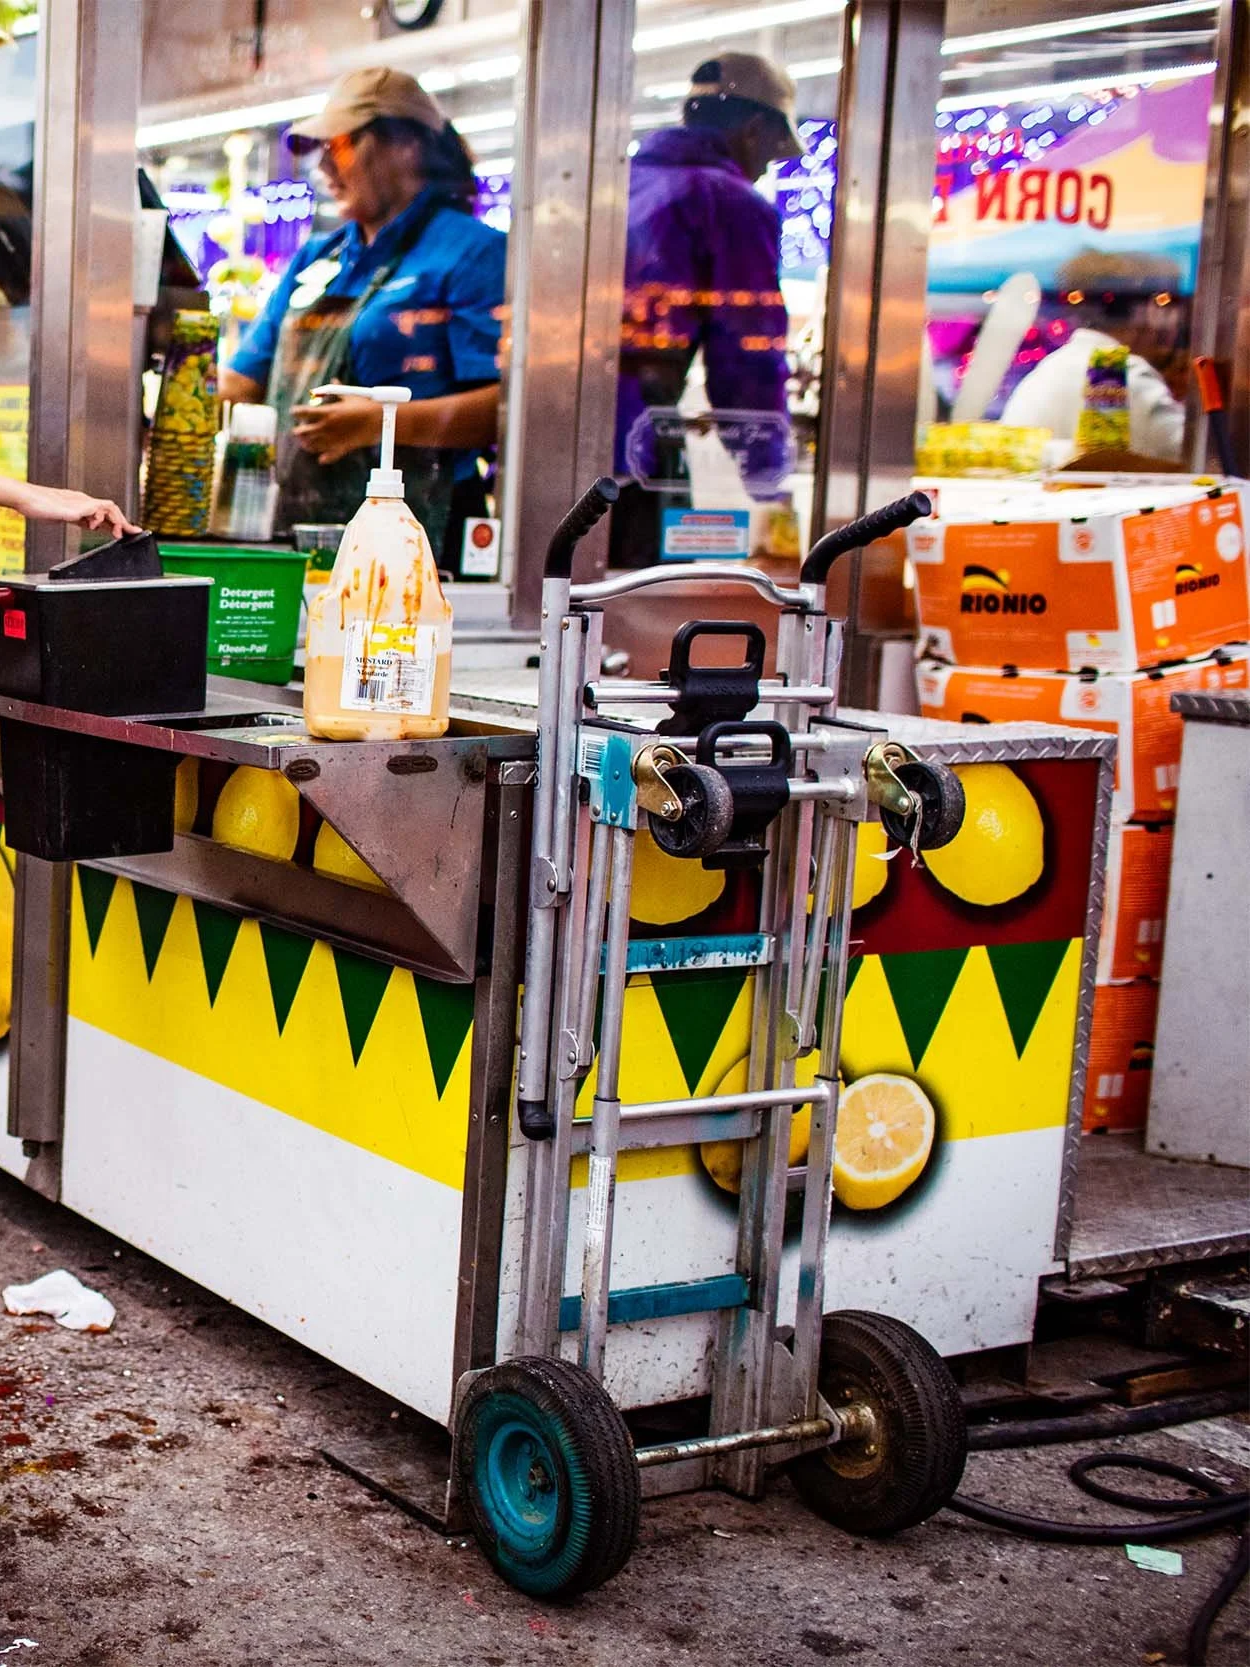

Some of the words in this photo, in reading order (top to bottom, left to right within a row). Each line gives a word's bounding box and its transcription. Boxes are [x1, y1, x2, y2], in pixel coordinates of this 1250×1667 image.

[1174, 574, 1220, 596] RIONIO
[220, 587, 275, 600] Detergent
[219, 599, 274, 612] Détergent
[960, 593, 1047, 614] RIONIO
[218, 644, 268, 653] Kleen-Pail
